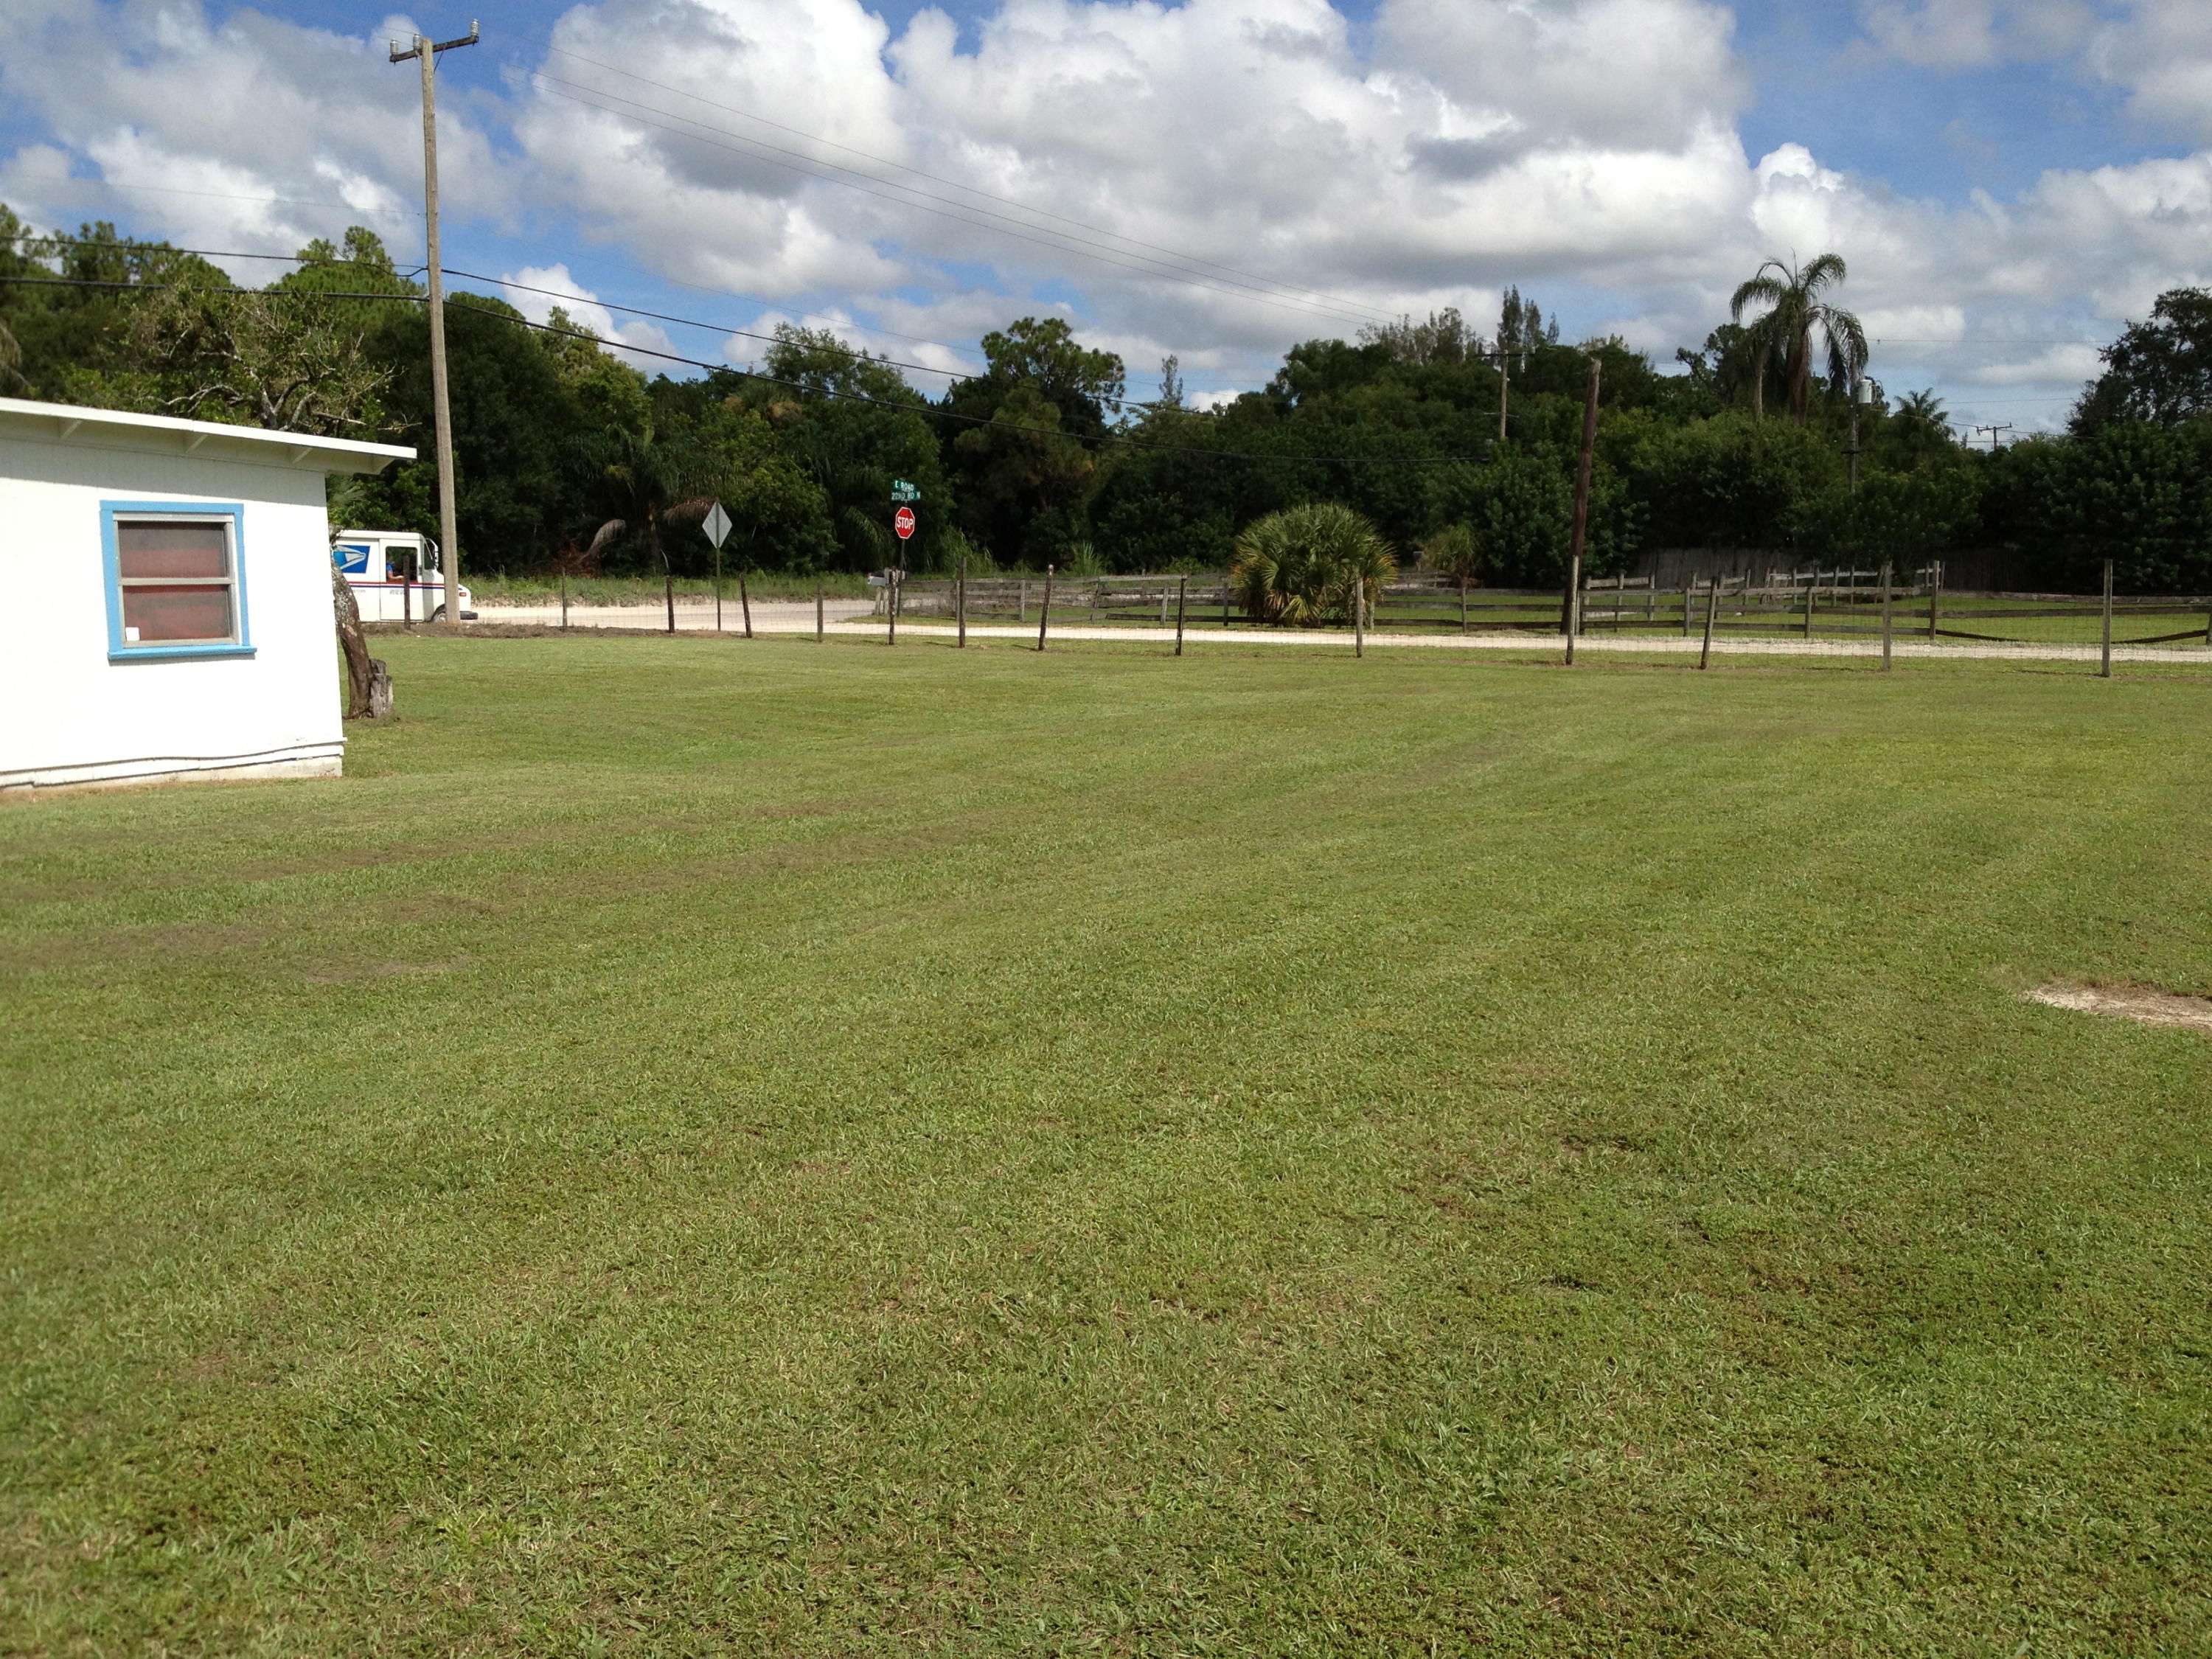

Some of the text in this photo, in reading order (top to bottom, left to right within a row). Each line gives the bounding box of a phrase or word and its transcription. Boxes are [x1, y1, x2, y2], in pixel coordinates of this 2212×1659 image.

[895, 480, 914, 491] E ROAD
[891, 492, 905, 501] 22ND
[907, 492, 915, 500] RD
[897, 516, 914, 529] STOP
